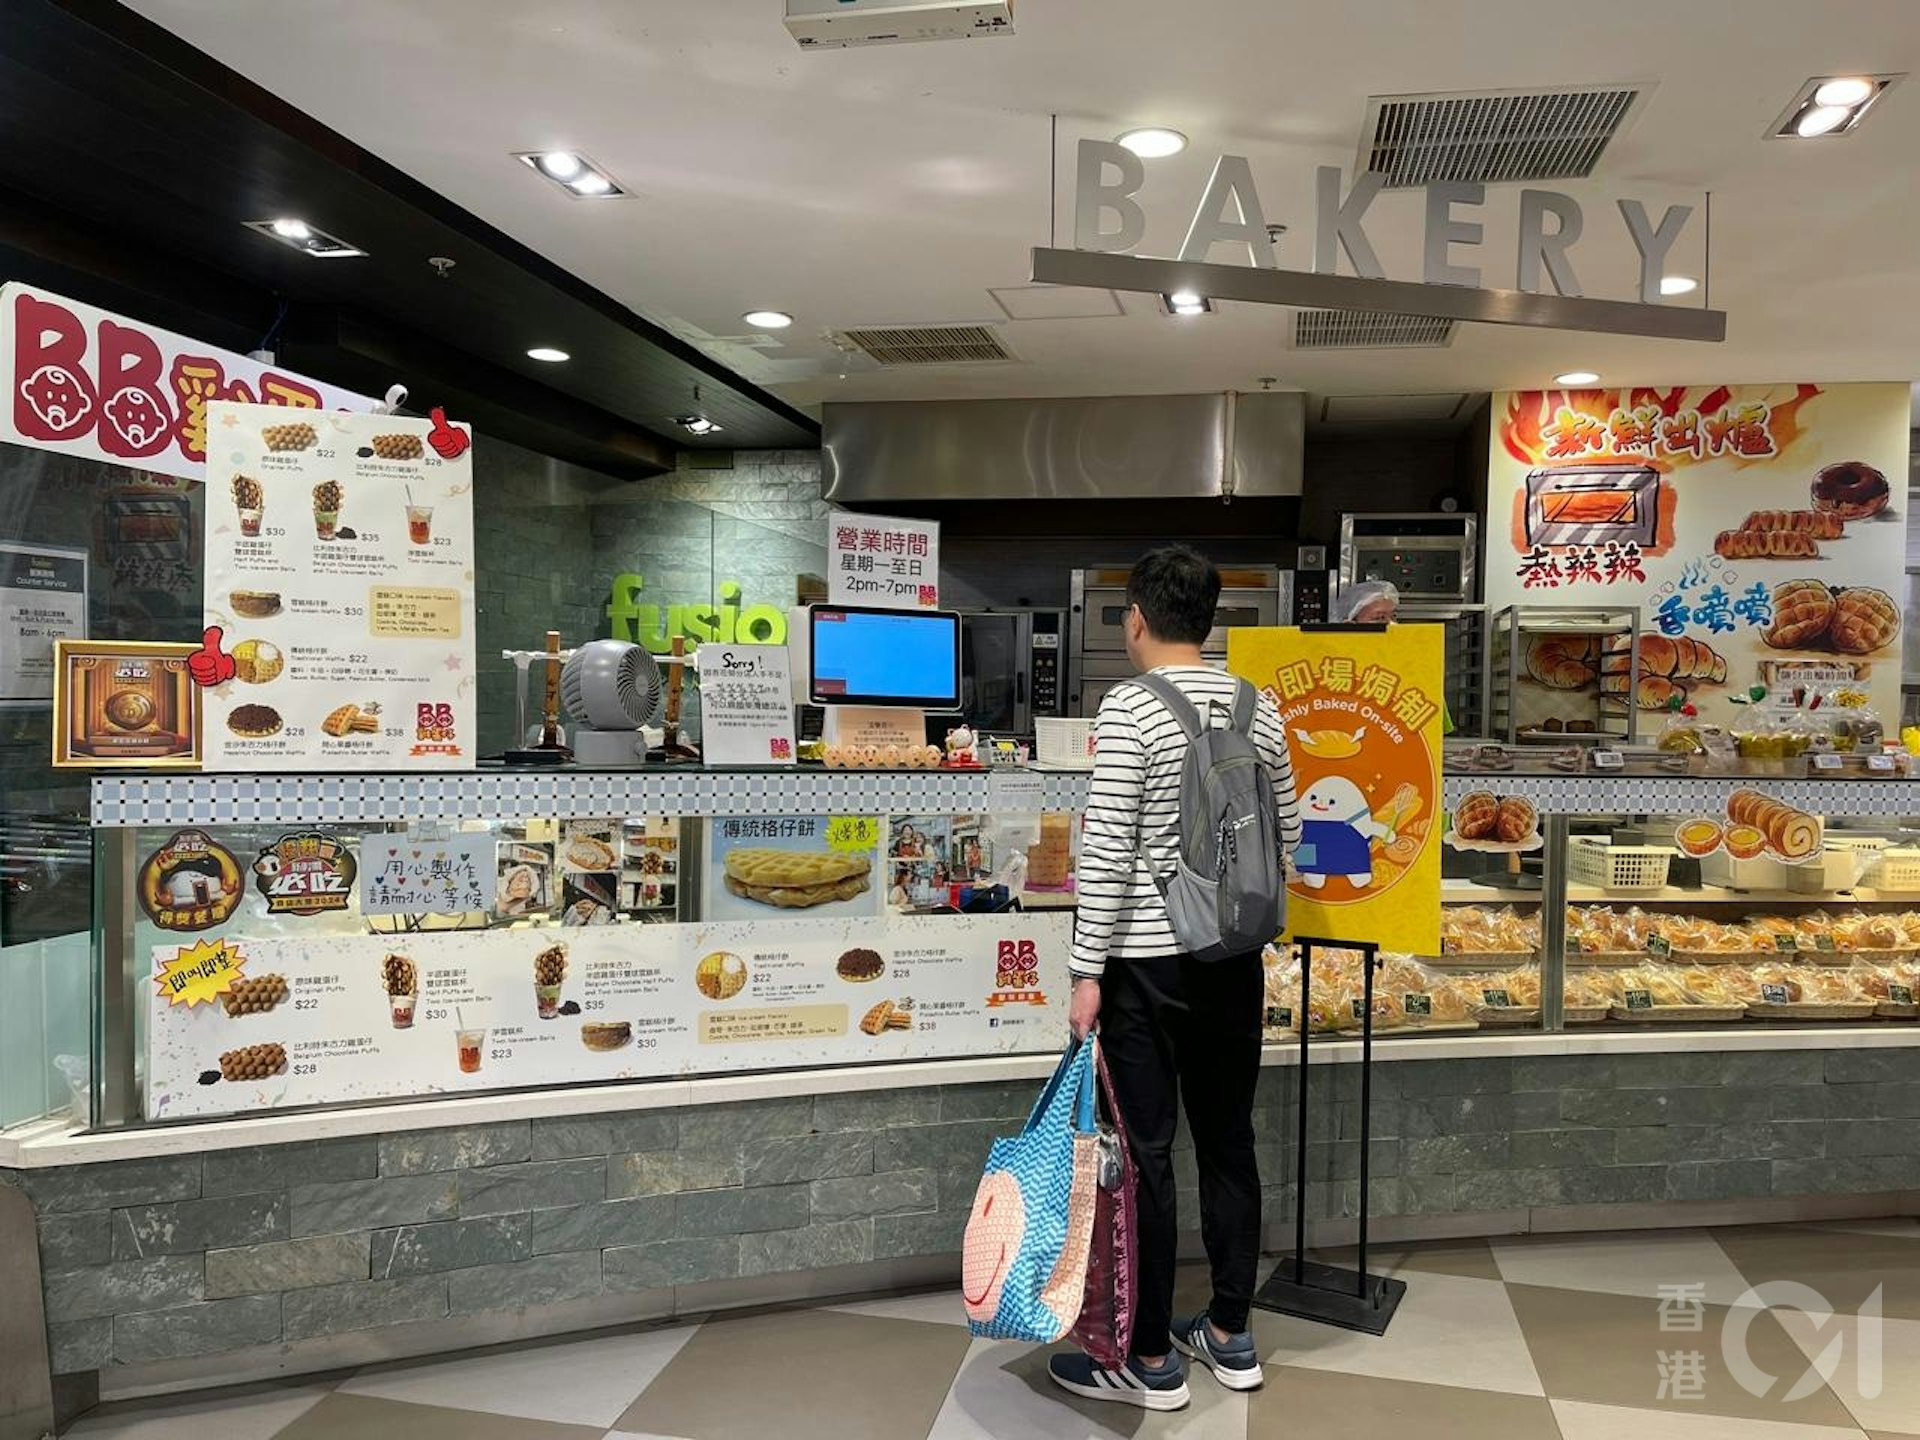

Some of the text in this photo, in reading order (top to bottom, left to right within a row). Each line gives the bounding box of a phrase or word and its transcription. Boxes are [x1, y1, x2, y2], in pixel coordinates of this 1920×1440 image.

[1075, 138, 1693, 302] BAKERY
[1545, 405, 1776, 457] 新鮮出爐
[316, 449, 335, 458] $22
[424, 458, 441, 467] $28
[265, 528, 285, 536] $30
[361, 533, 380, 542] $35
[433, 538, 451, 546] $23
[837, 526, 928, 557] 營業時間
[841, 553, 922, 576] 星期一至日
[1516, 542, 1646, 589] 熱辣辣
[847, 576, 917, 595] 2pm-7pm
[344, 606, 363, 616] $30
[606, 573, 788, 654] fusio
[1652, 583, 1773, 637] 香噴噴
[349, 655, 368, 663] $22
[1313, 697, 1358, 714] Baked
[1360, 706, 1404, 744] On-site
[285, 728, 305, 736] $28
[385, 728, 405, 736] $38
[723, 819, 815, 838] 傳統格仔餅
[383, 859, 476, 880] 用心製作
[267, 871, 349, 895] 必吃
[368, 885, 484, 910] 請耐心等候
[997, 940, 1038, 971] BB
[753, 974, 772, 983] $22
[893, 970, 910, 979] $28
[295, 1000, 318, 1010] $22
[584, 1001, 605, 1010] $35
[425, 1009, 447, 1020] $30
[919, 1022, 937, 1031] $38
[637, 1039, 657, 1049] $30
[491, 1049, 512, 1060] $23
[293, 1065, 317, 1075] $28
